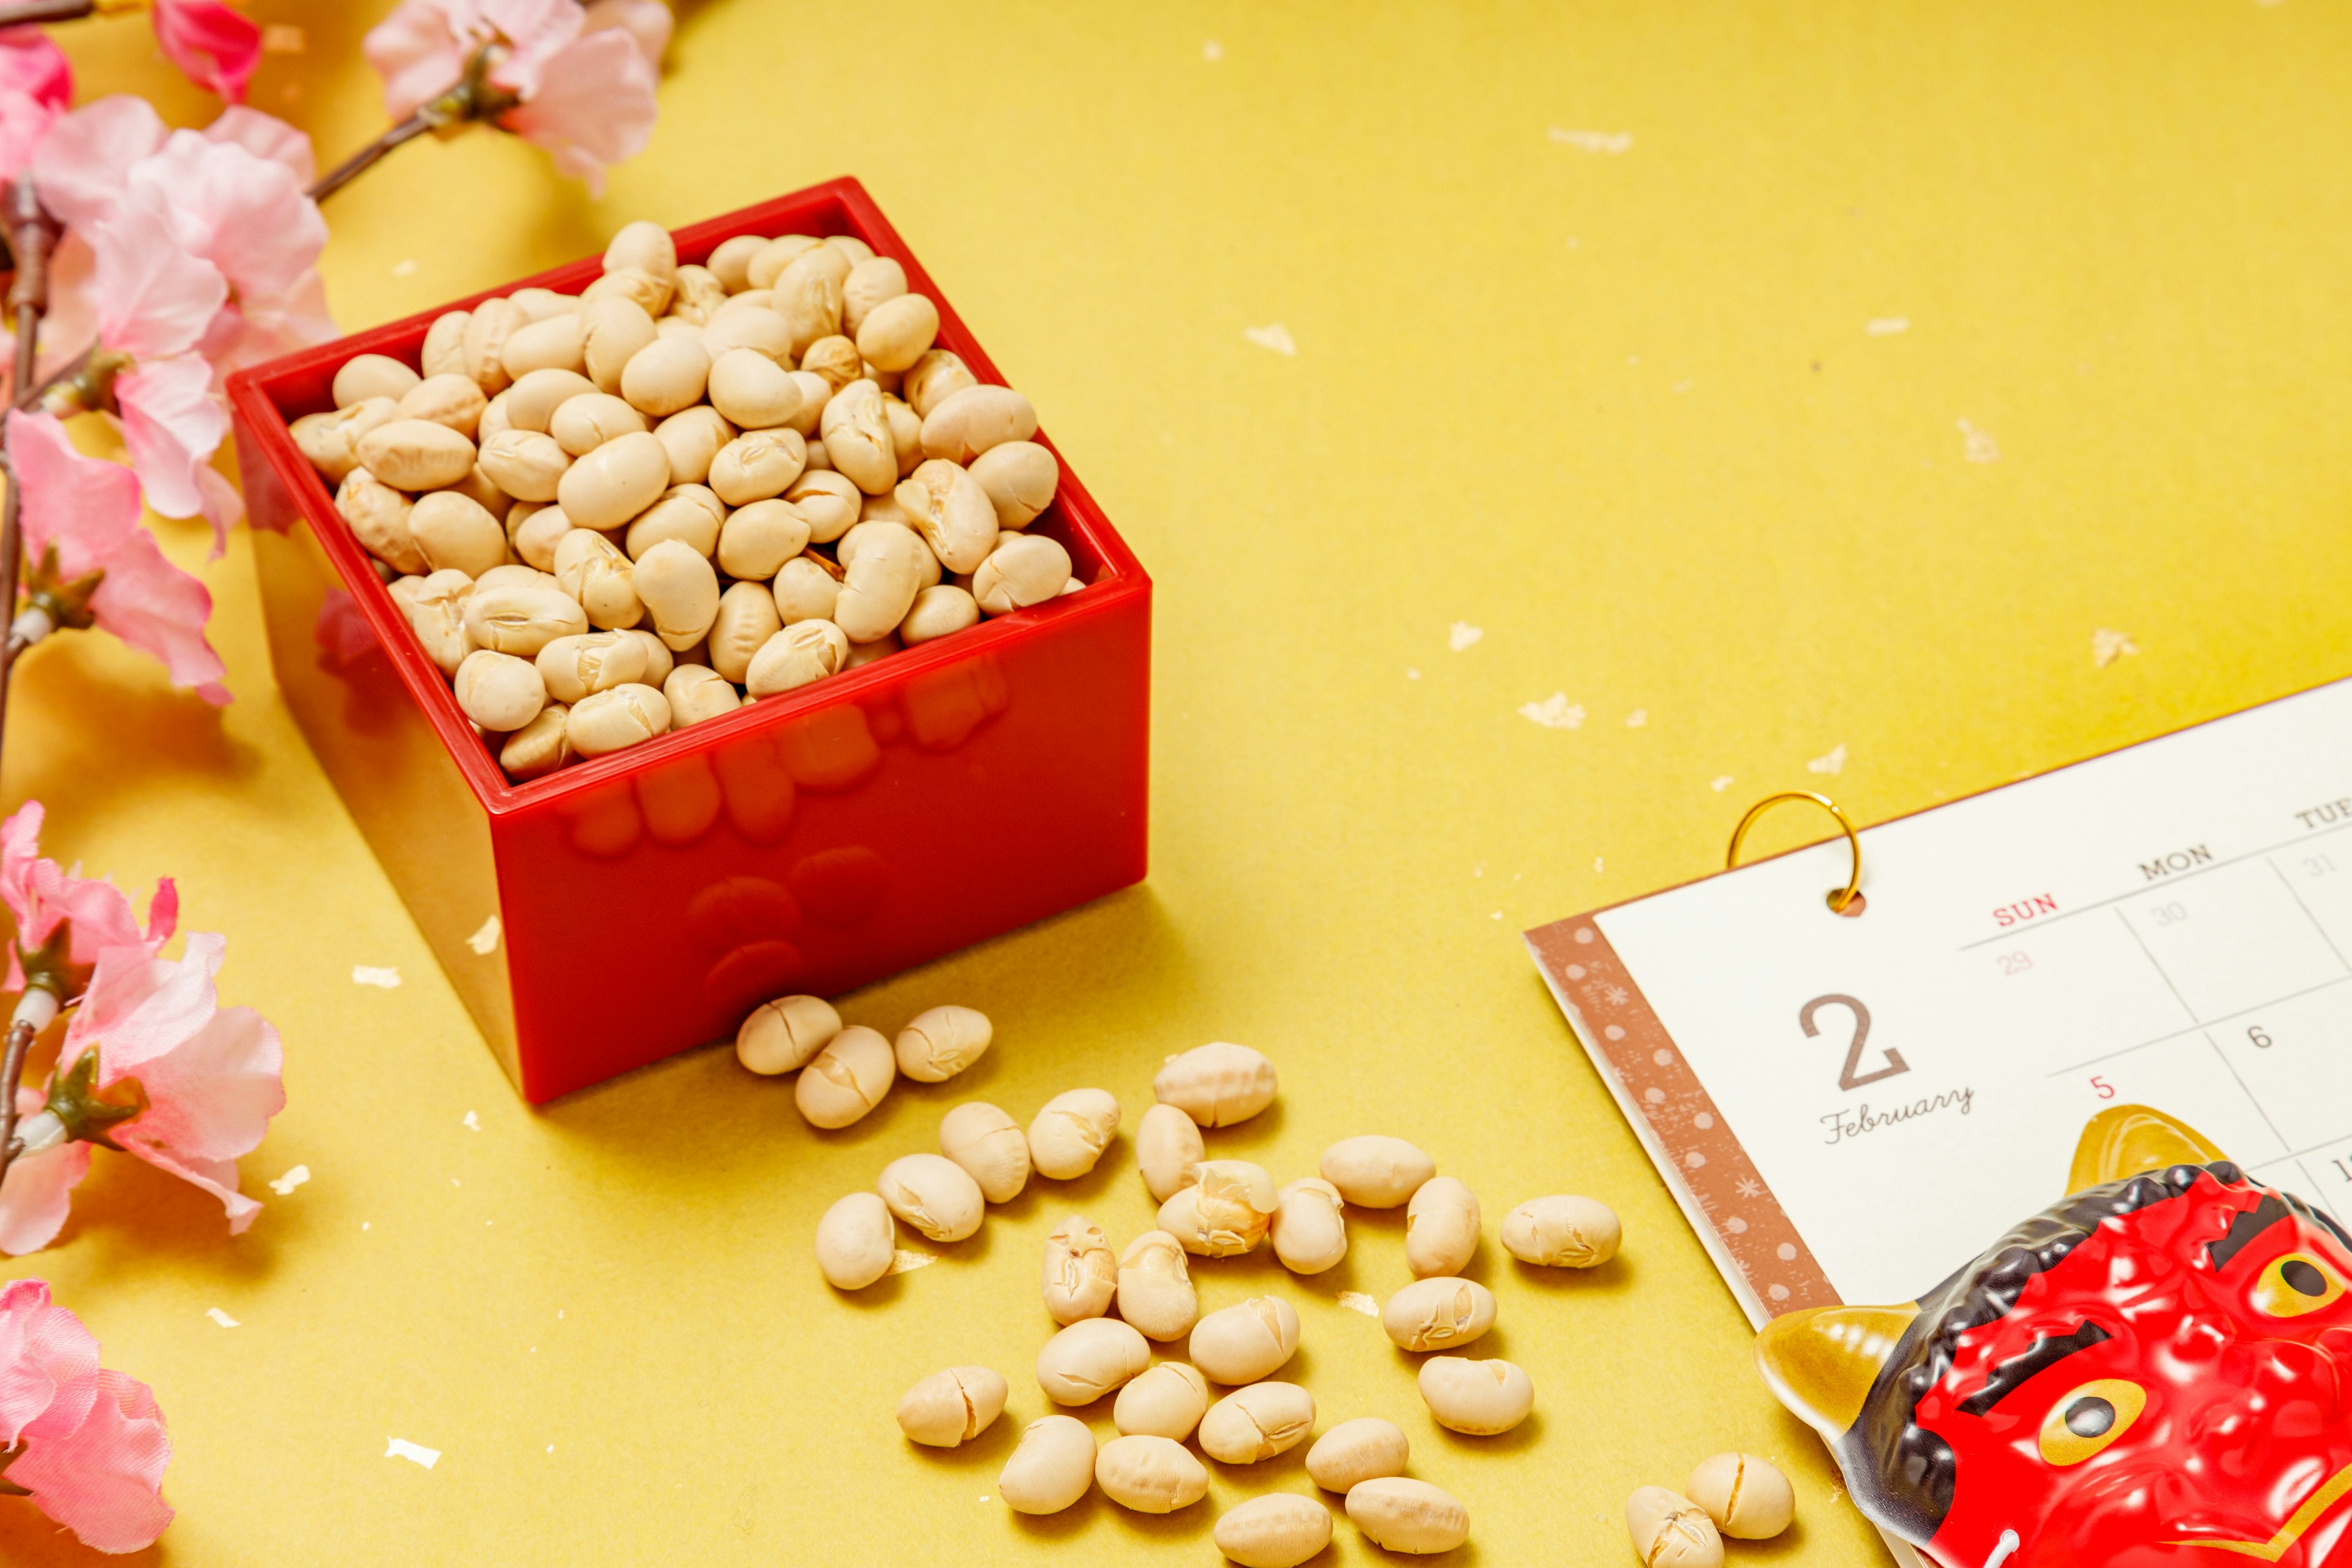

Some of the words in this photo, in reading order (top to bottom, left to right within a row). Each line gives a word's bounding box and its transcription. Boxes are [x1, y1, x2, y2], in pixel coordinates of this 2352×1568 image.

[1992, 893, 2058, 927] SUN
[2138, 843, 2214, 881] MON
[1996, 950, 2034, 976] 29
[2150, 902, 2188, 927] 30
[2302, 853, 2337, 878] 31
[1799, 993, 1910, 1092] 2
[2089, 1075, 2116, 1099] 5
[2247, 1025, 2272, 1049] 6
[1819, 1087, 1975, 1145] February
